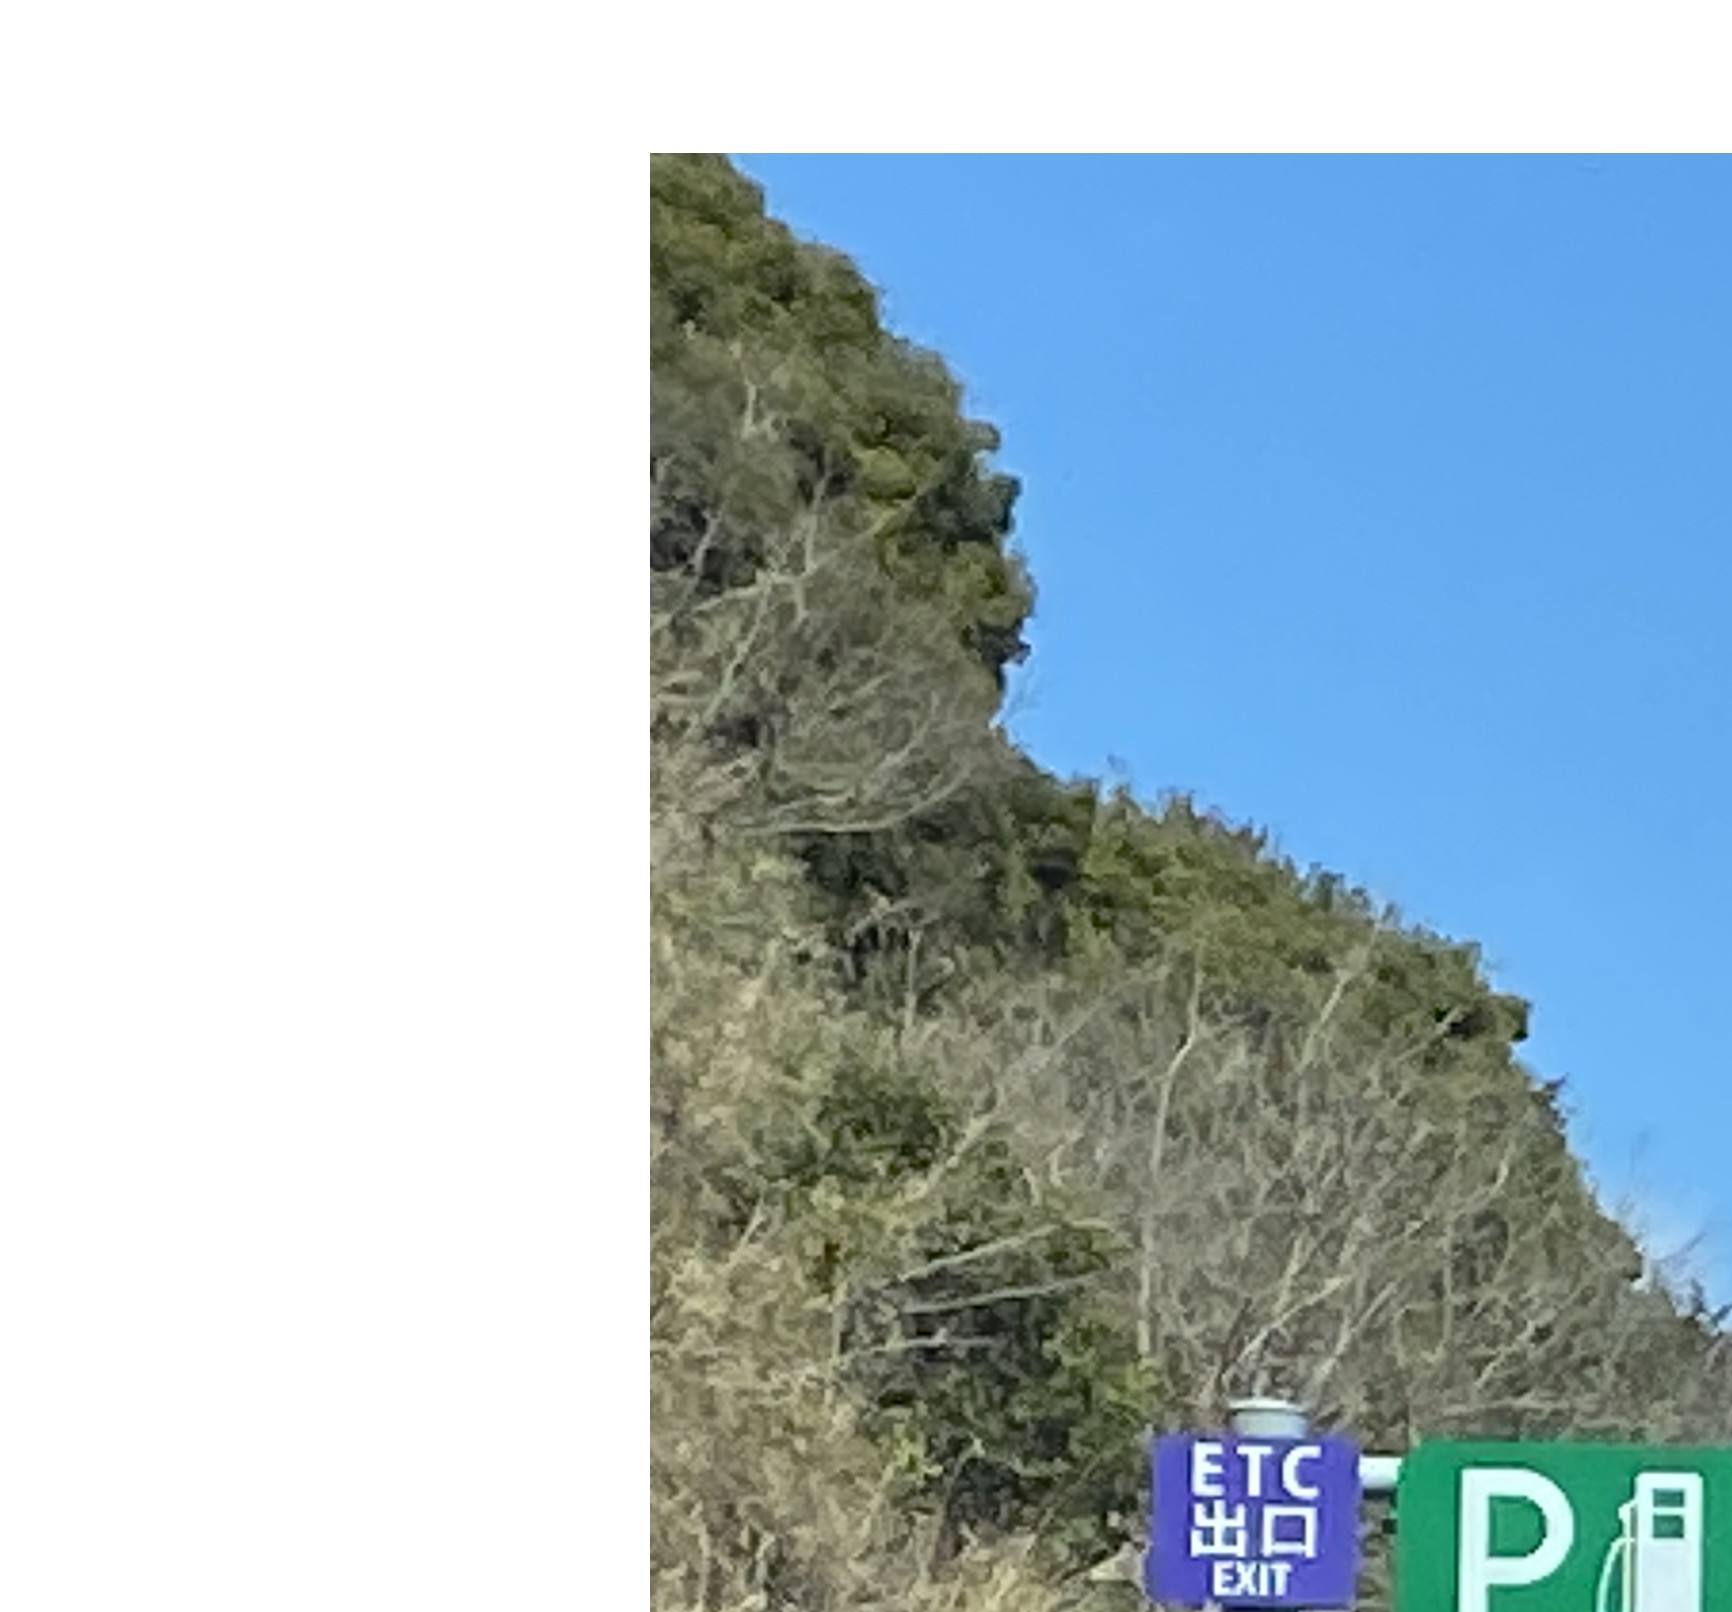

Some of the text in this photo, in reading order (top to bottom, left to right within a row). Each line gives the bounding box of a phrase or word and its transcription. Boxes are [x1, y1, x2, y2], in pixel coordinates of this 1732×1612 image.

[1191, 1441, 1322, 1499] ETC
[1190, 1500, 1318, 1558] 出口
[1213, 1560, 1291, 1596] EXIT
